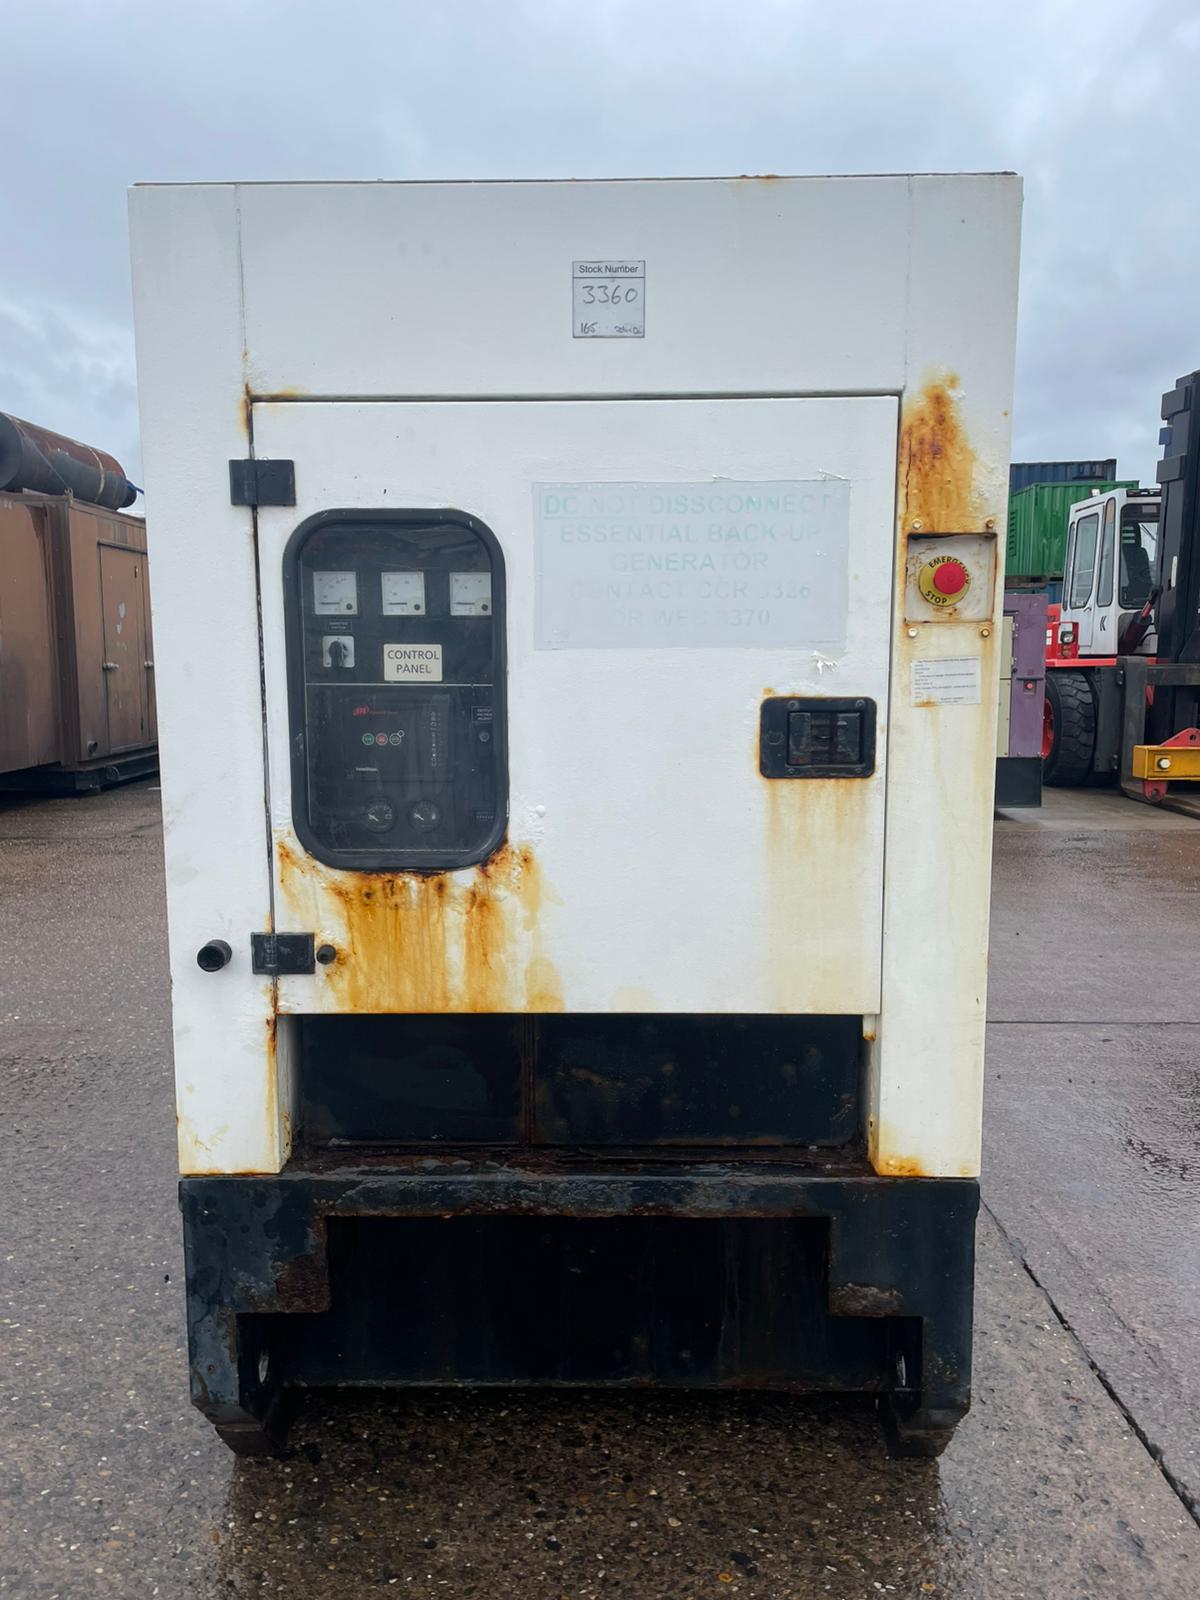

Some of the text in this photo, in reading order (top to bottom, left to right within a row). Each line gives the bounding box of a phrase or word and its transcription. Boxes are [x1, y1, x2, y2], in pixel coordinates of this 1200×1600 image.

[579, 264, 639, 273] Stock Number
[582, 285, 638, 304] 3360
[589, 494, 640, 515] NOT
[649, 492, 831, 515] DISSCONNECT
[560, 524, 699, 544] ESSENTIAL
[610, 551, 770, 573] GENERATOR
[925, 590, 948, 604] STOP
[716, 609, 771, 627] 370
[387, 650, 440, 660] CONTROL
[396, 664, 432, 674] PANEL
